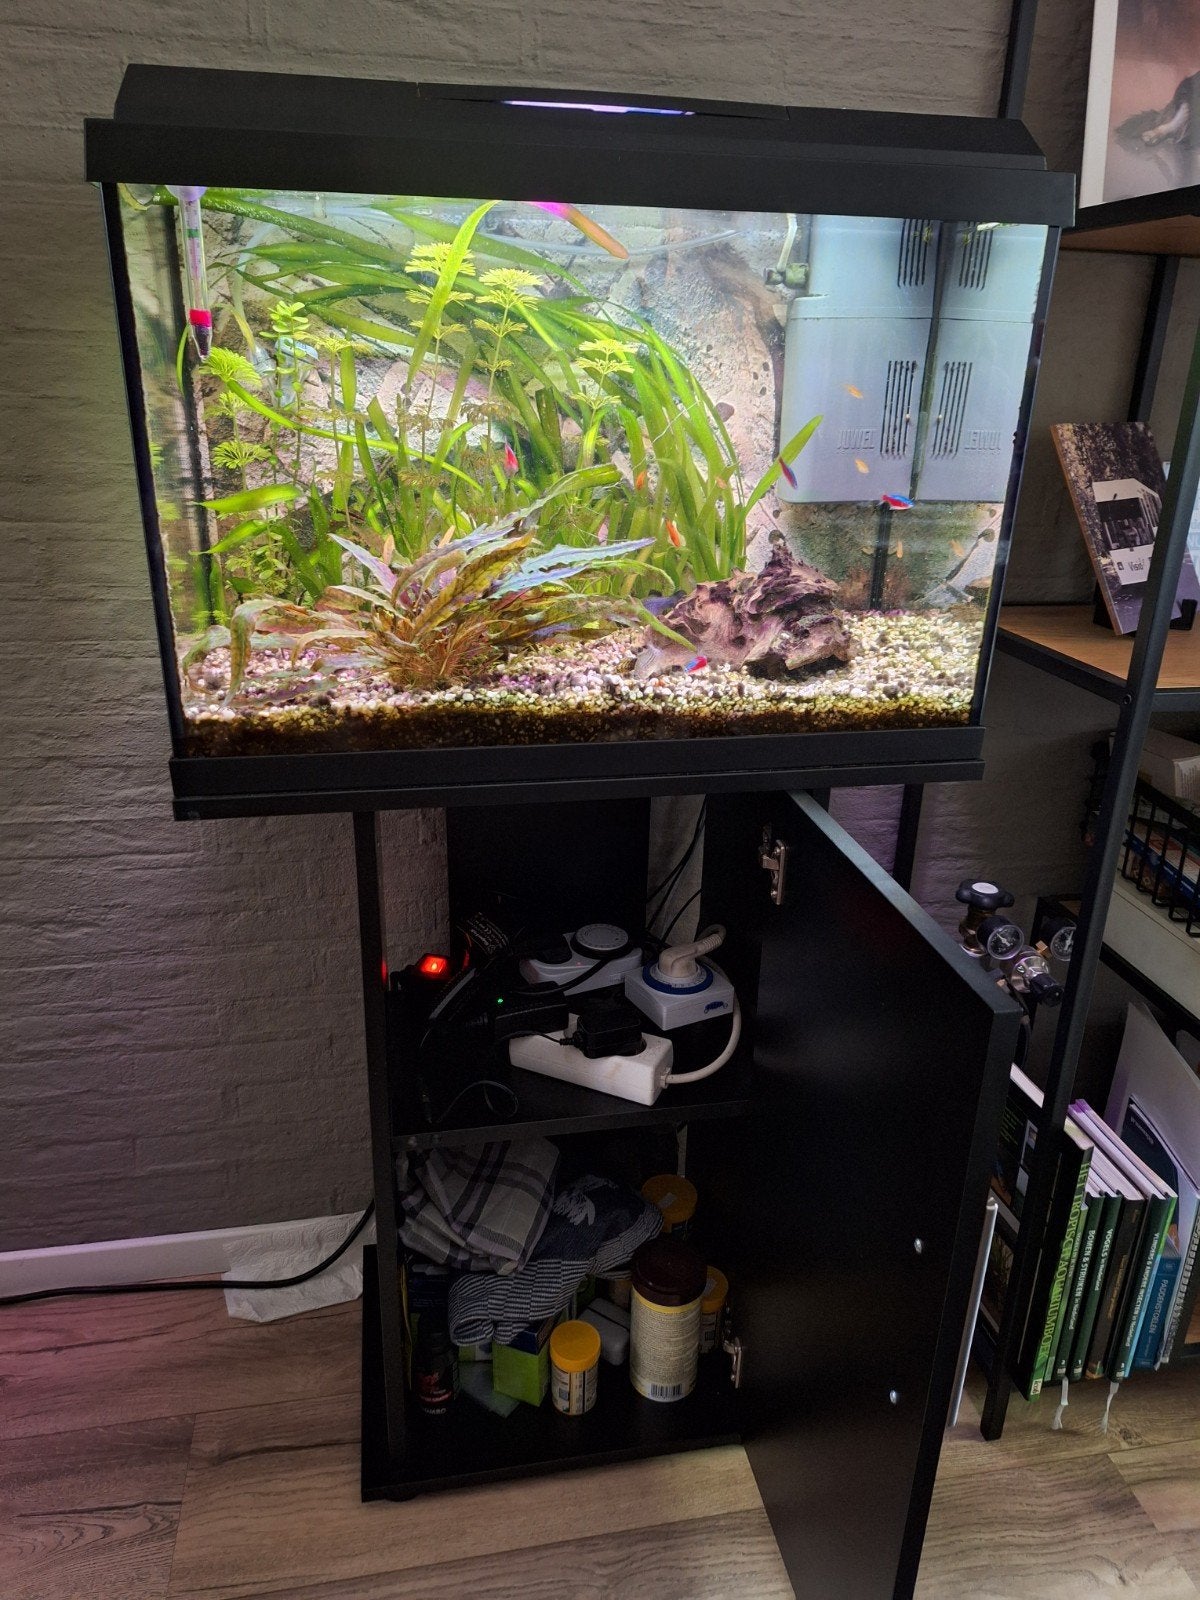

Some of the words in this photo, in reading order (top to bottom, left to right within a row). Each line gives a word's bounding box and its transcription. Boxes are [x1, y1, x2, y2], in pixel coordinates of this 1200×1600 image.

[836, 428, 877, 450] JUWEL
[1077, 1162, 1089, 1189] HET
[1061, 1193, 1083, 1261] TROPISCH
[1084, 1229, 1096, 1256] BOMEN
[1102, 1228, 1114, 1257] VOGELS
[1149, 1232, 1160, 1259] VLINDERS
[1075, 1262, 1088, 1297] STRUIKEN
[1095, 1263, 1105, 1290] Nederland
[1142, 1265, 1151, 1289] ANDERE
[1038, 1261, 1069, 1360] AQUARIUMBOEK
[1134, 1289, 1146, 1315] INSECTEN
[1149, 1279, 1168, 1333] PADDENSTOELEN
[1068, 1303, 1079, 1330] Nederland
[1125, 1321, 1137, 1347] Nederland
